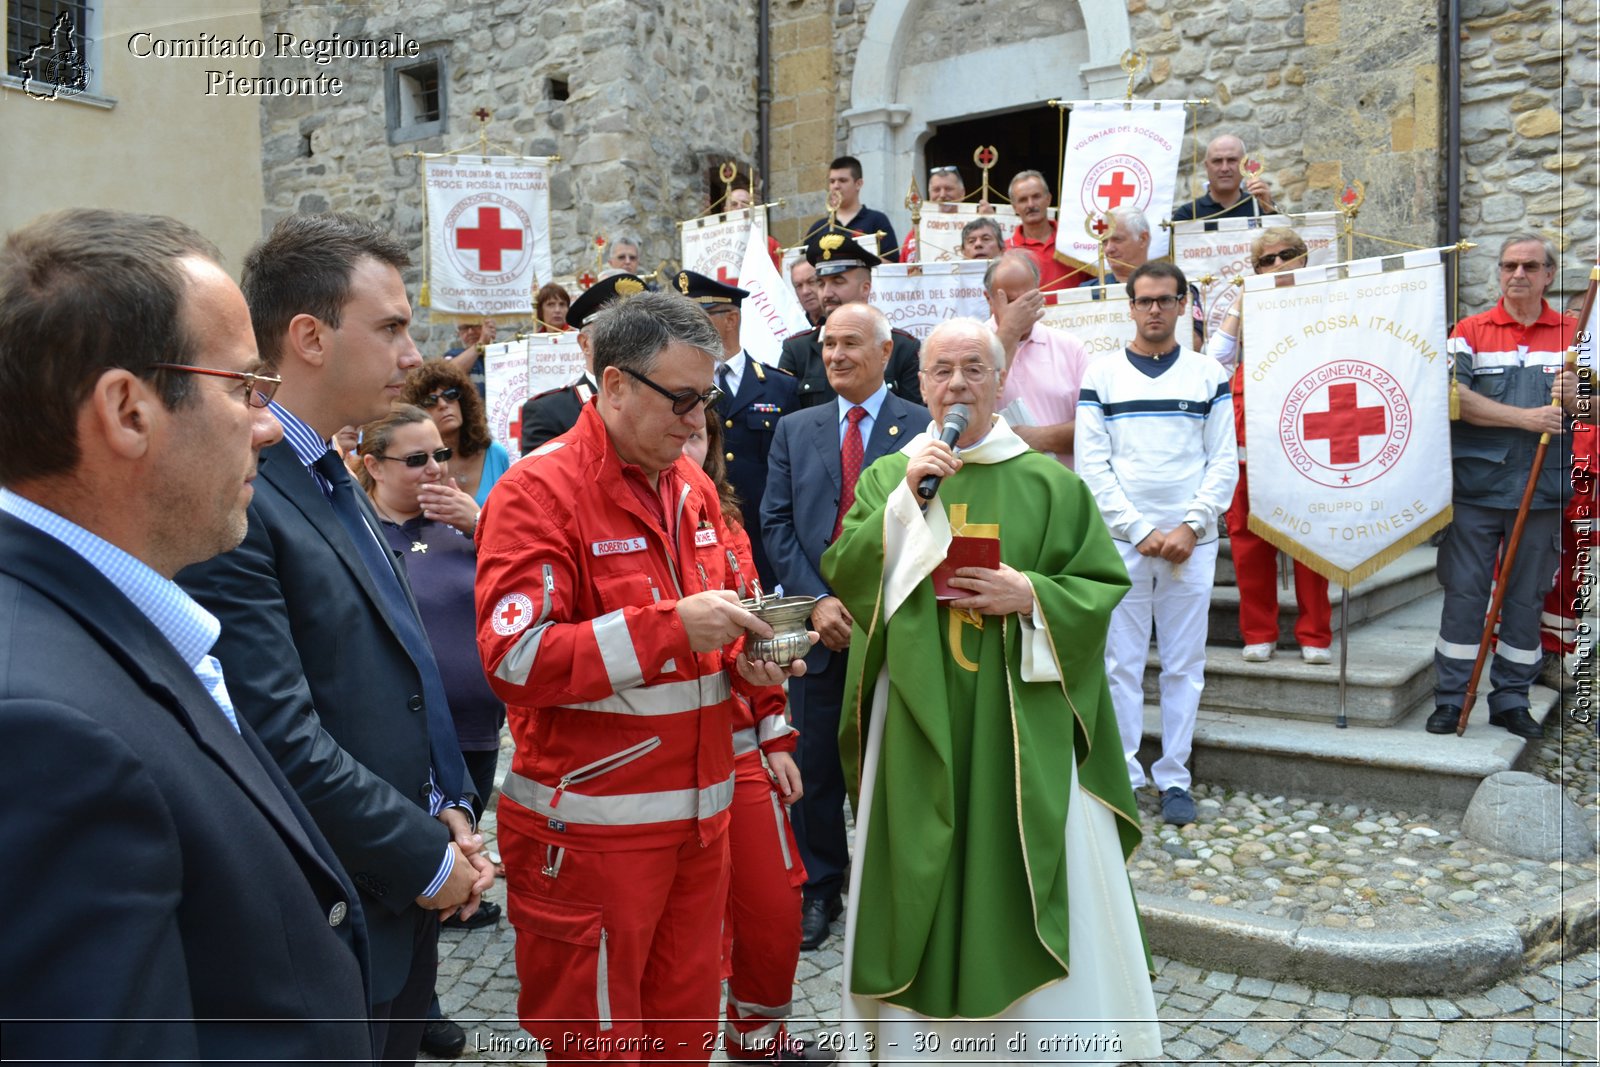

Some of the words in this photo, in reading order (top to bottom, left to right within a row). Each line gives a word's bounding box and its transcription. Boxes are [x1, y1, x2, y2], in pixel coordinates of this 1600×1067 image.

[1074, 127, 1116, 151] VOLONTARI
[1134, 127, 1172, 151] SOCCORSO
[432, 169, 453, 178] CORPO
[456, 170, 492, 178] VOLONTARI
[495, 172, 507, 180] DEL
[510, 172, 542, 180] SOCCORSO
[1085, 158, 1124, 191] CONVENZIONE
[1132, 162, 1148, 191] GINEVRA
[427, 180, 462, 190] CROCE
[466, 180, 502, 190] ROSSA
[504, 182, 548, 190] ITALIANA
[445, 193, 492, 228] CONVENZIONE
[926, 220, 950, 230] CORPO
[1183, 247, 1212, 260] CORPO
[440, 287, 488, 297] COMITATO
[490, 288, 529, 297] LOCALE
[880, 290, 925, 301] VOLONTARI
[929, 288, 946, 300] DEL
[1256, 296, 1324, 312] VOLONTARI
[1328, 292, 1350, 304] DEL
[1356, 280, 1428, 298] SOCCORSO
[456, 300, 530, 312] RACCONIGI
[744, 280, 790, 342] CROCE
[884, 304, 938, 324] ROSSA
[1059, 315, 1107, 328] VOLONTARI
[1110, 313, 1124, 324] DEL
[1251, 336, 1298, 382] CROCE
[1303, 314, 1360, 338] ROSSA
[1369, 316, 1438, 364] ITALIANA
[536, 353, 556, 362] CORPO
[530, 365, 566, 375] CROCE
[1318, 364, 1372, 382] GINEVRA
[1304, 377, 1318, 391] DI
[1372, 372, 1391, 388] 22
[1386, 386, 1408, 440] AGOSTO
[1282, 388, 1314, 472] CONVENZIONE
[1378, 443, 1400, 468] 1864
[1308, 501, 1364, 514] GRUPPO
[1370, 500, 1384, 511] DI
[1271, 506, 1313, 536] PINO
[1328, 500, 1429, 541] TORINESE
[598, 542, 630, 554] ROBERTO
[634, 540, 642, 549] S.
